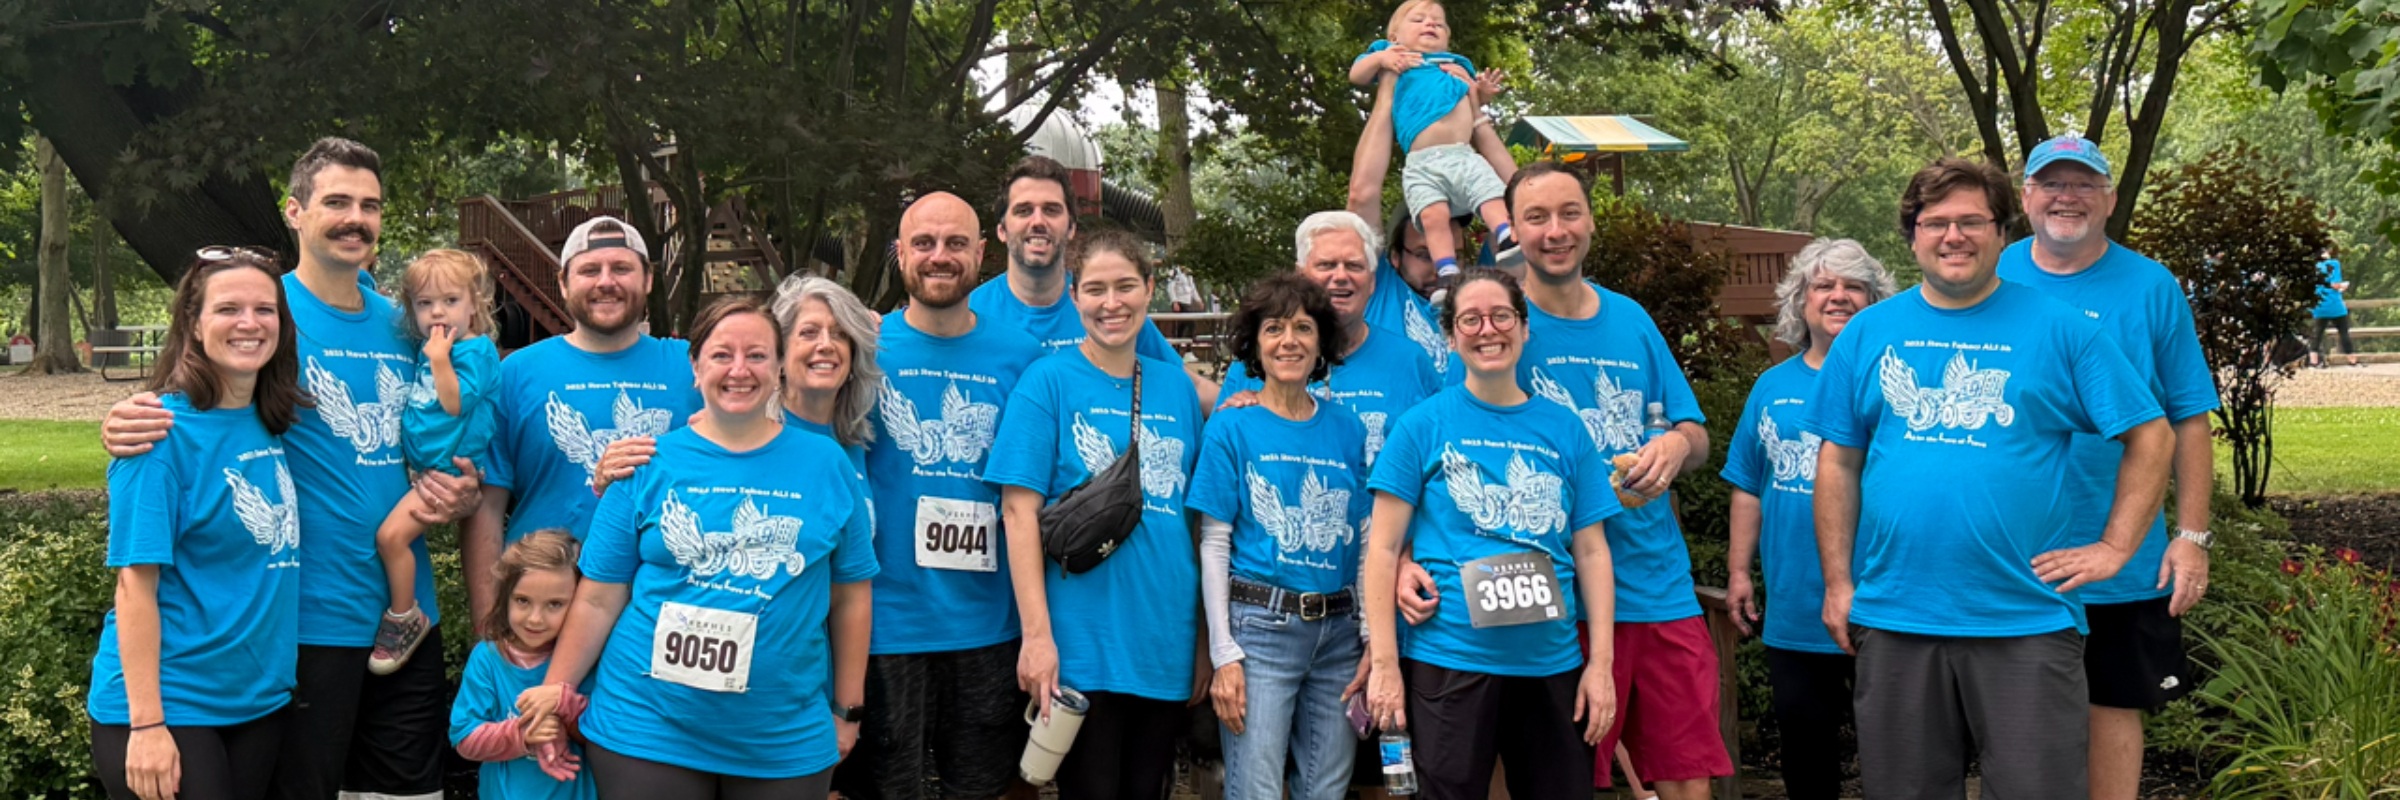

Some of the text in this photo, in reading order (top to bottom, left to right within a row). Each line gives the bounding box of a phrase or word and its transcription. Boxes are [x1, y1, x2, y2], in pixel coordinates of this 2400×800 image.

[926, 522, 987, 555] 9044
[1476, 574, 1552, 611] 3966
[665, 631, 738, 674] 9050
